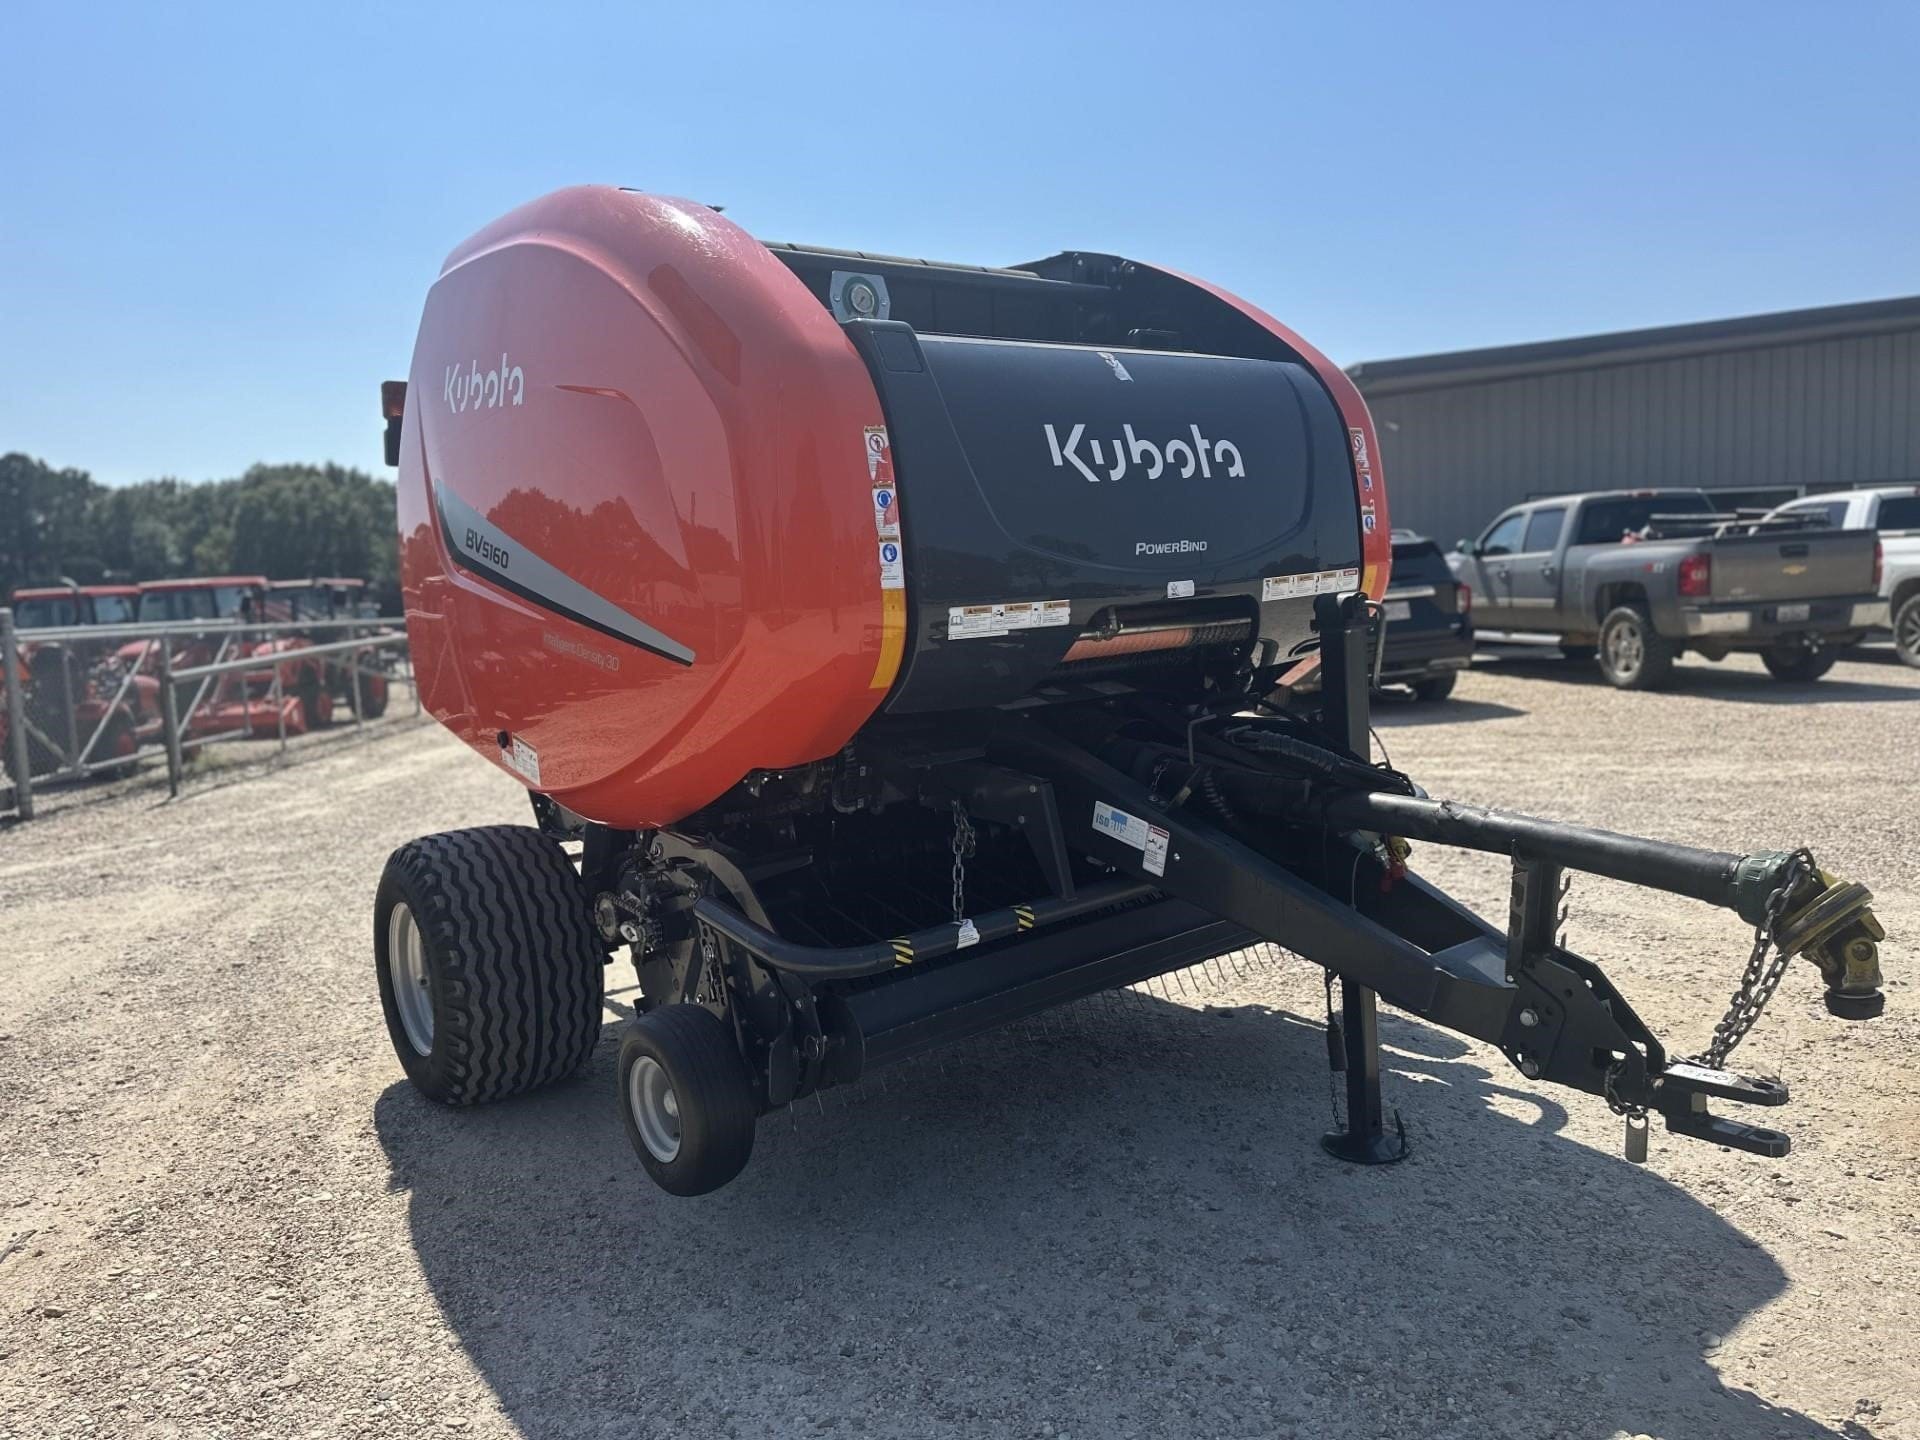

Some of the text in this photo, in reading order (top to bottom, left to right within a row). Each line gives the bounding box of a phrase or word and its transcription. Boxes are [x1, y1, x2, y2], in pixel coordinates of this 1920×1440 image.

[444, 352, 524, 414] Kubota
[1044, 424, 1245, 482] Kubota
[465, 527, 509, 569] BV5160
